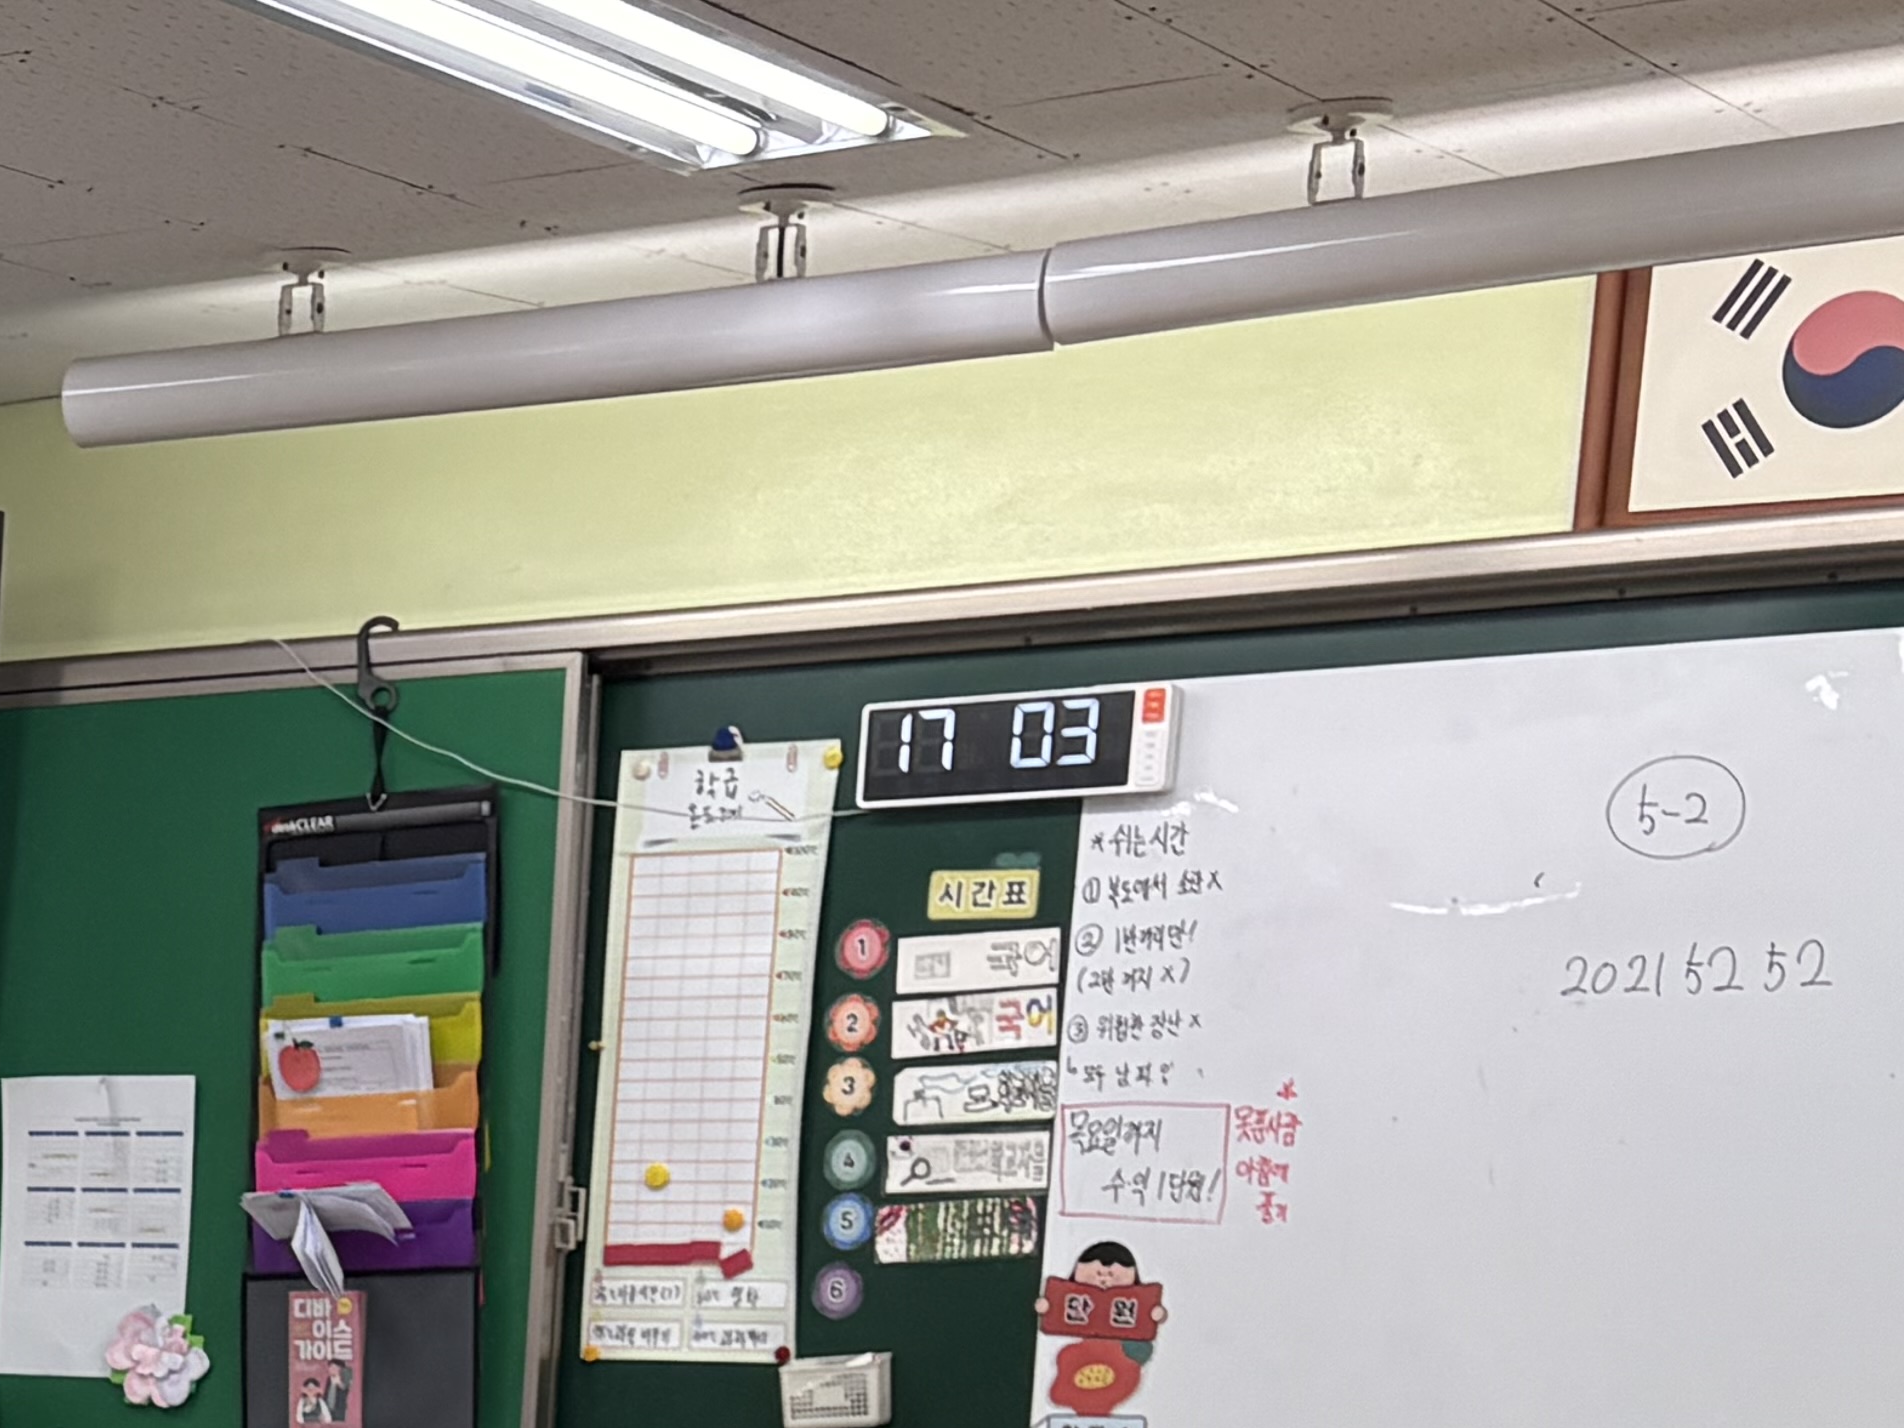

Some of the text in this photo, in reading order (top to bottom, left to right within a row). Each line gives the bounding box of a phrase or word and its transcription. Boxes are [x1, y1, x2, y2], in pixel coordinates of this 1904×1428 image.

[898, 698, 1100, 773] 17 03
[1638, 782, 1709, 836] 5-2
[938, 880, 1027, 909] 시간표
[857, 938, 866, 956] 1
[847, 1014, 859, 1032] 2
[842, 1077, 855, 1095] 3
[843, 1152, 856, 1169] 4
[841, 1212, 853, 1230] 5
[830, 1279, 844, 1301] 6
[294, 1298, 332, 1318] 디바
[312, 1319, 352, 1339] 이스
[294, 1340, 353, 1360] 가이드
